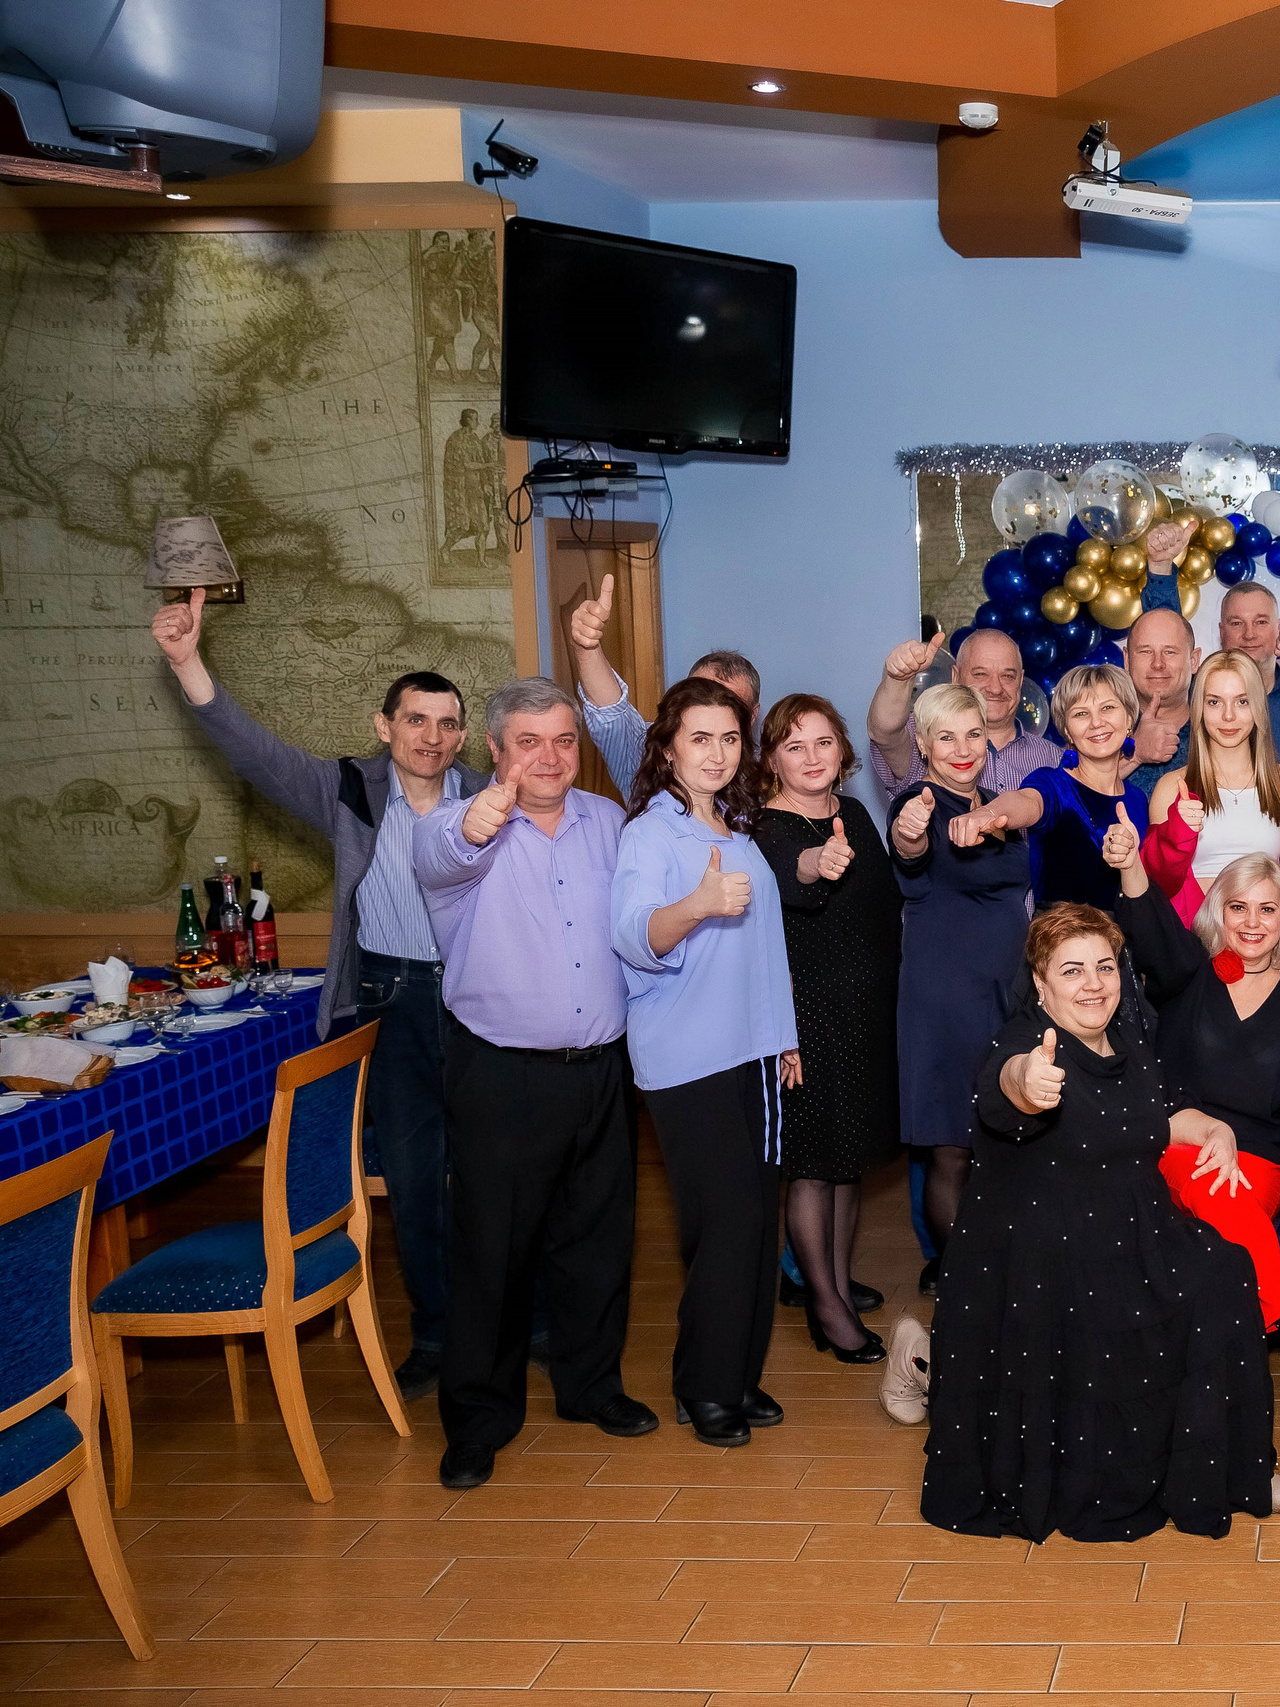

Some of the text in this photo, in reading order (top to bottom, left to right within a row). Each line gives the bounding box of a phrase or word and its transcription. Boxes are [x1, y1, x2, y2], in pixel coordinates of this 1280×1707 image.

[319, 399, 386, 415] THE
[29, 655, 60, 666] THE
[90, 693, 159, 712] SEA
[44, 816, 143, 837] AMERICA
